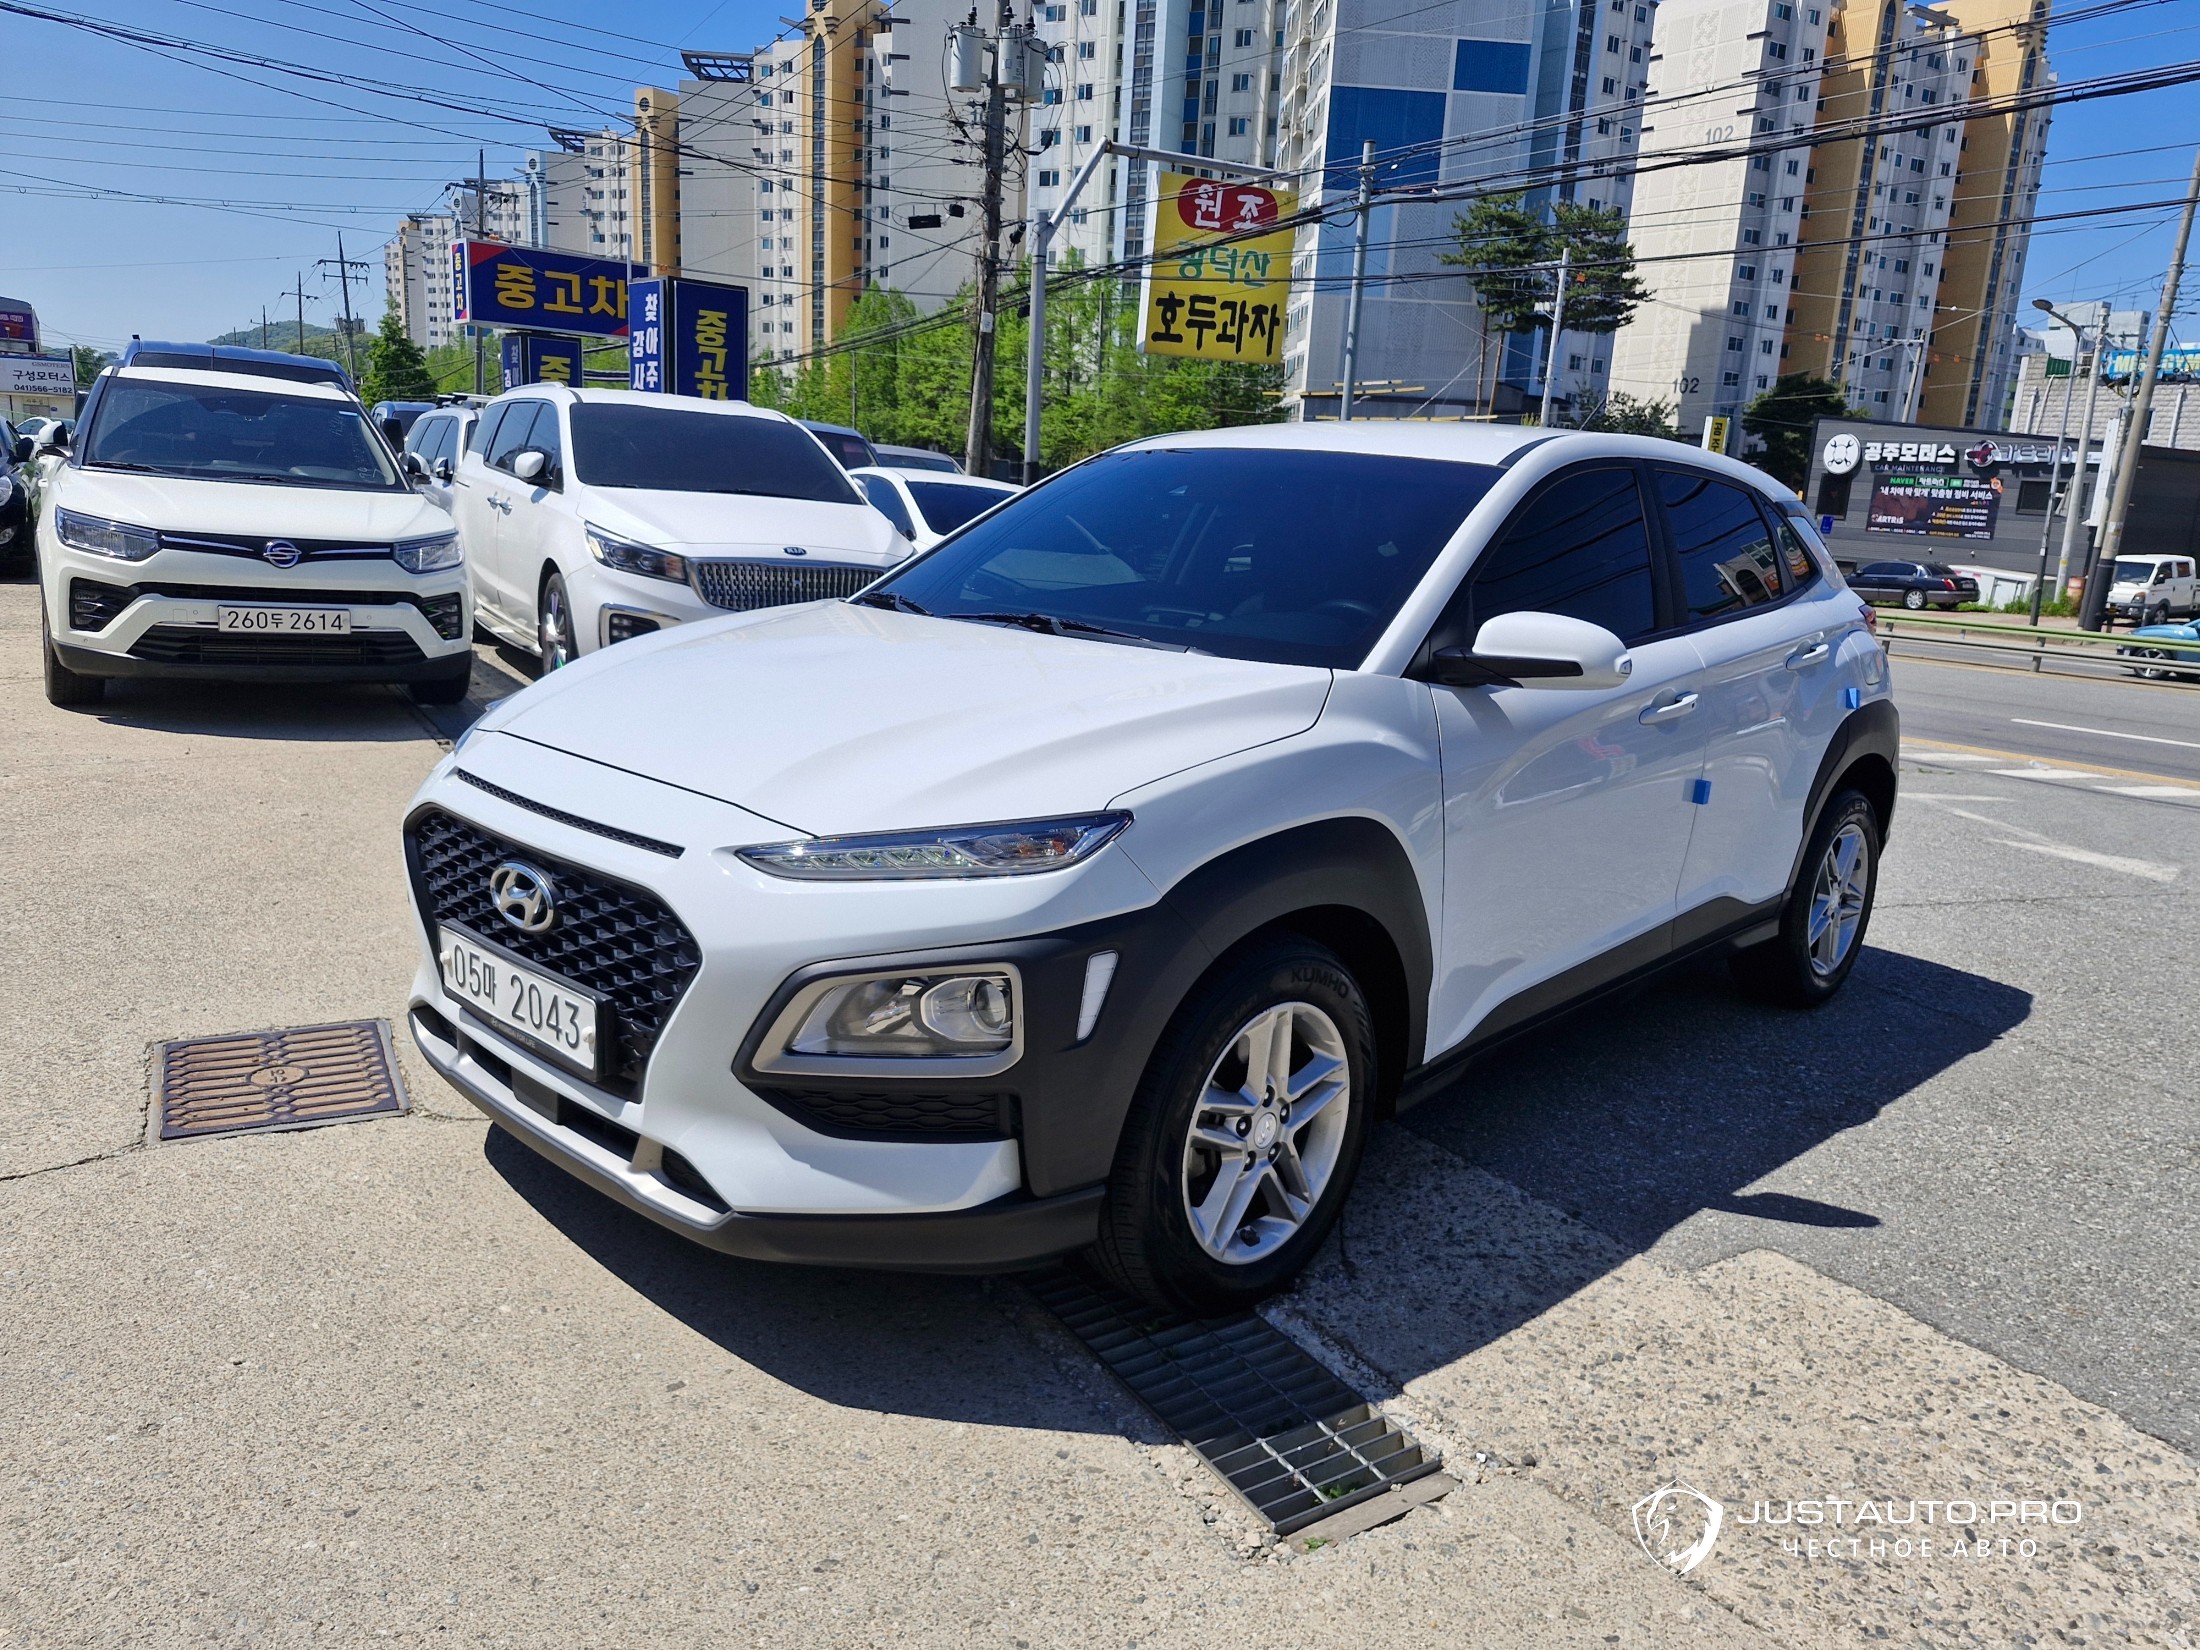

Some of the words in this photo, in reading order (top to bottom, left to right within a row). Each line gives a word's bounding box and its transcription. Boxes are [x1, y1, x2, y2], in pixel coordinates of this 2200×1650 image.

[1706, 125, 1735, 144] 102
[1194, 183, 1265, 231] 원조
[455, 252, 464, 311] 중고차
[495, 263, 629, 319] 중고차
[1151, 291, 1281, 357] 호두과자
[13, 369, 71, 382] 구성모터스
[14, 384, 73, 394] 041)566-5182
[1672, 378, 1700, 394] 102
[1864, 442, 1956, 463] 공주모터스
[1892, 464, 1946, 473] MAINTENANCE
[1889, 476, 1915, 485] NAVER
[1970, 490, 1993, 501] 서비스
[786, 547, 805, 555] KIA
[227, 610, 284, 629] 260두
[290, 612, 344, 631] 2614
[1291, 966, 1349, 999] KUMHO
[454, 944, 497, 1006] 05마
[510, 974, 580, 1049] 2043
